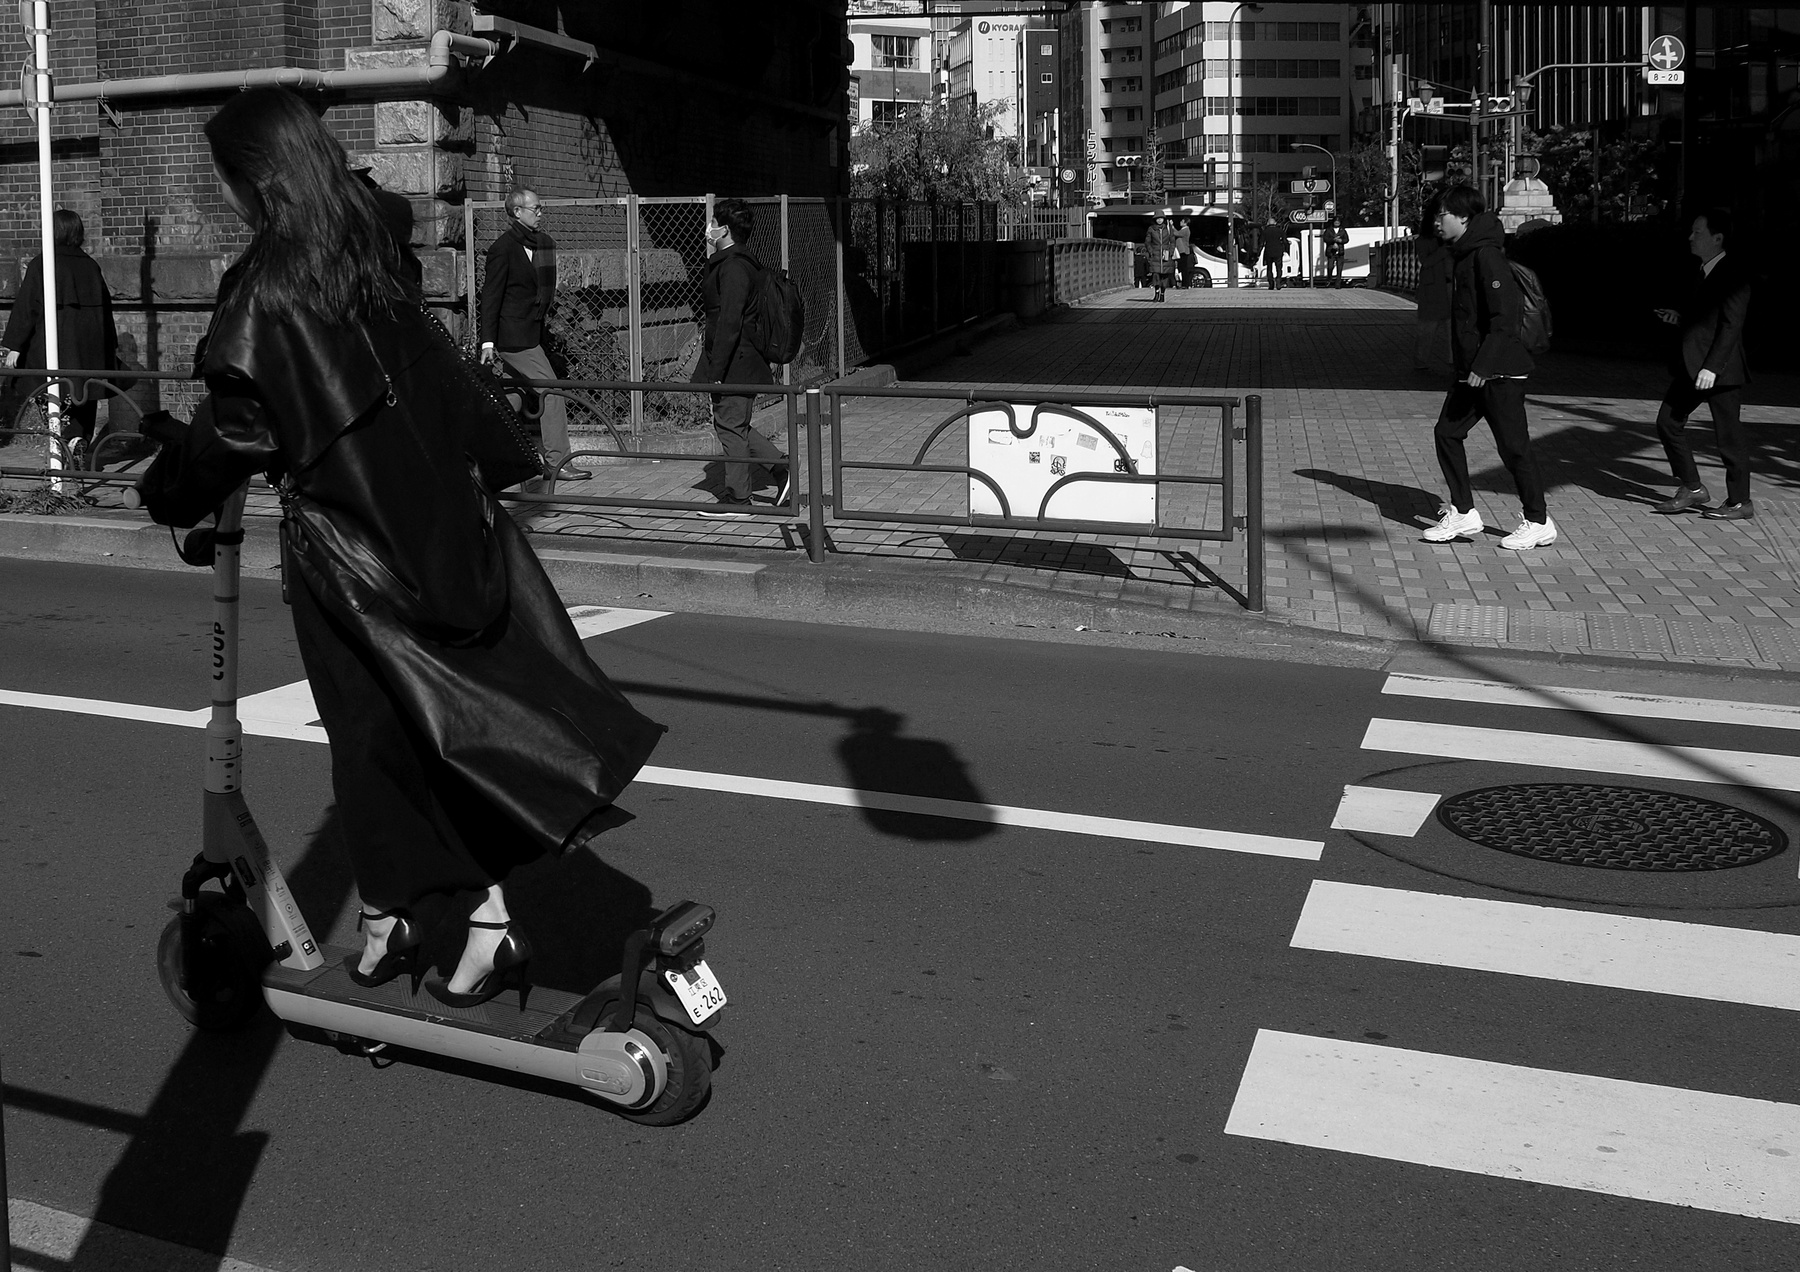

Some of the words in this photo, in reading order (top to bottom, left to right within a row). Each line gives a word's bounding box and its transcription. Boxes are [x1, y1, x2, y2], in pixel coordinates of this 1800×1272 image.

[992, 24, 1028, 32] KYORAK
[1086, 128, 1097, 200] トランクルー
[213, 621, 225, 681] LUUP
